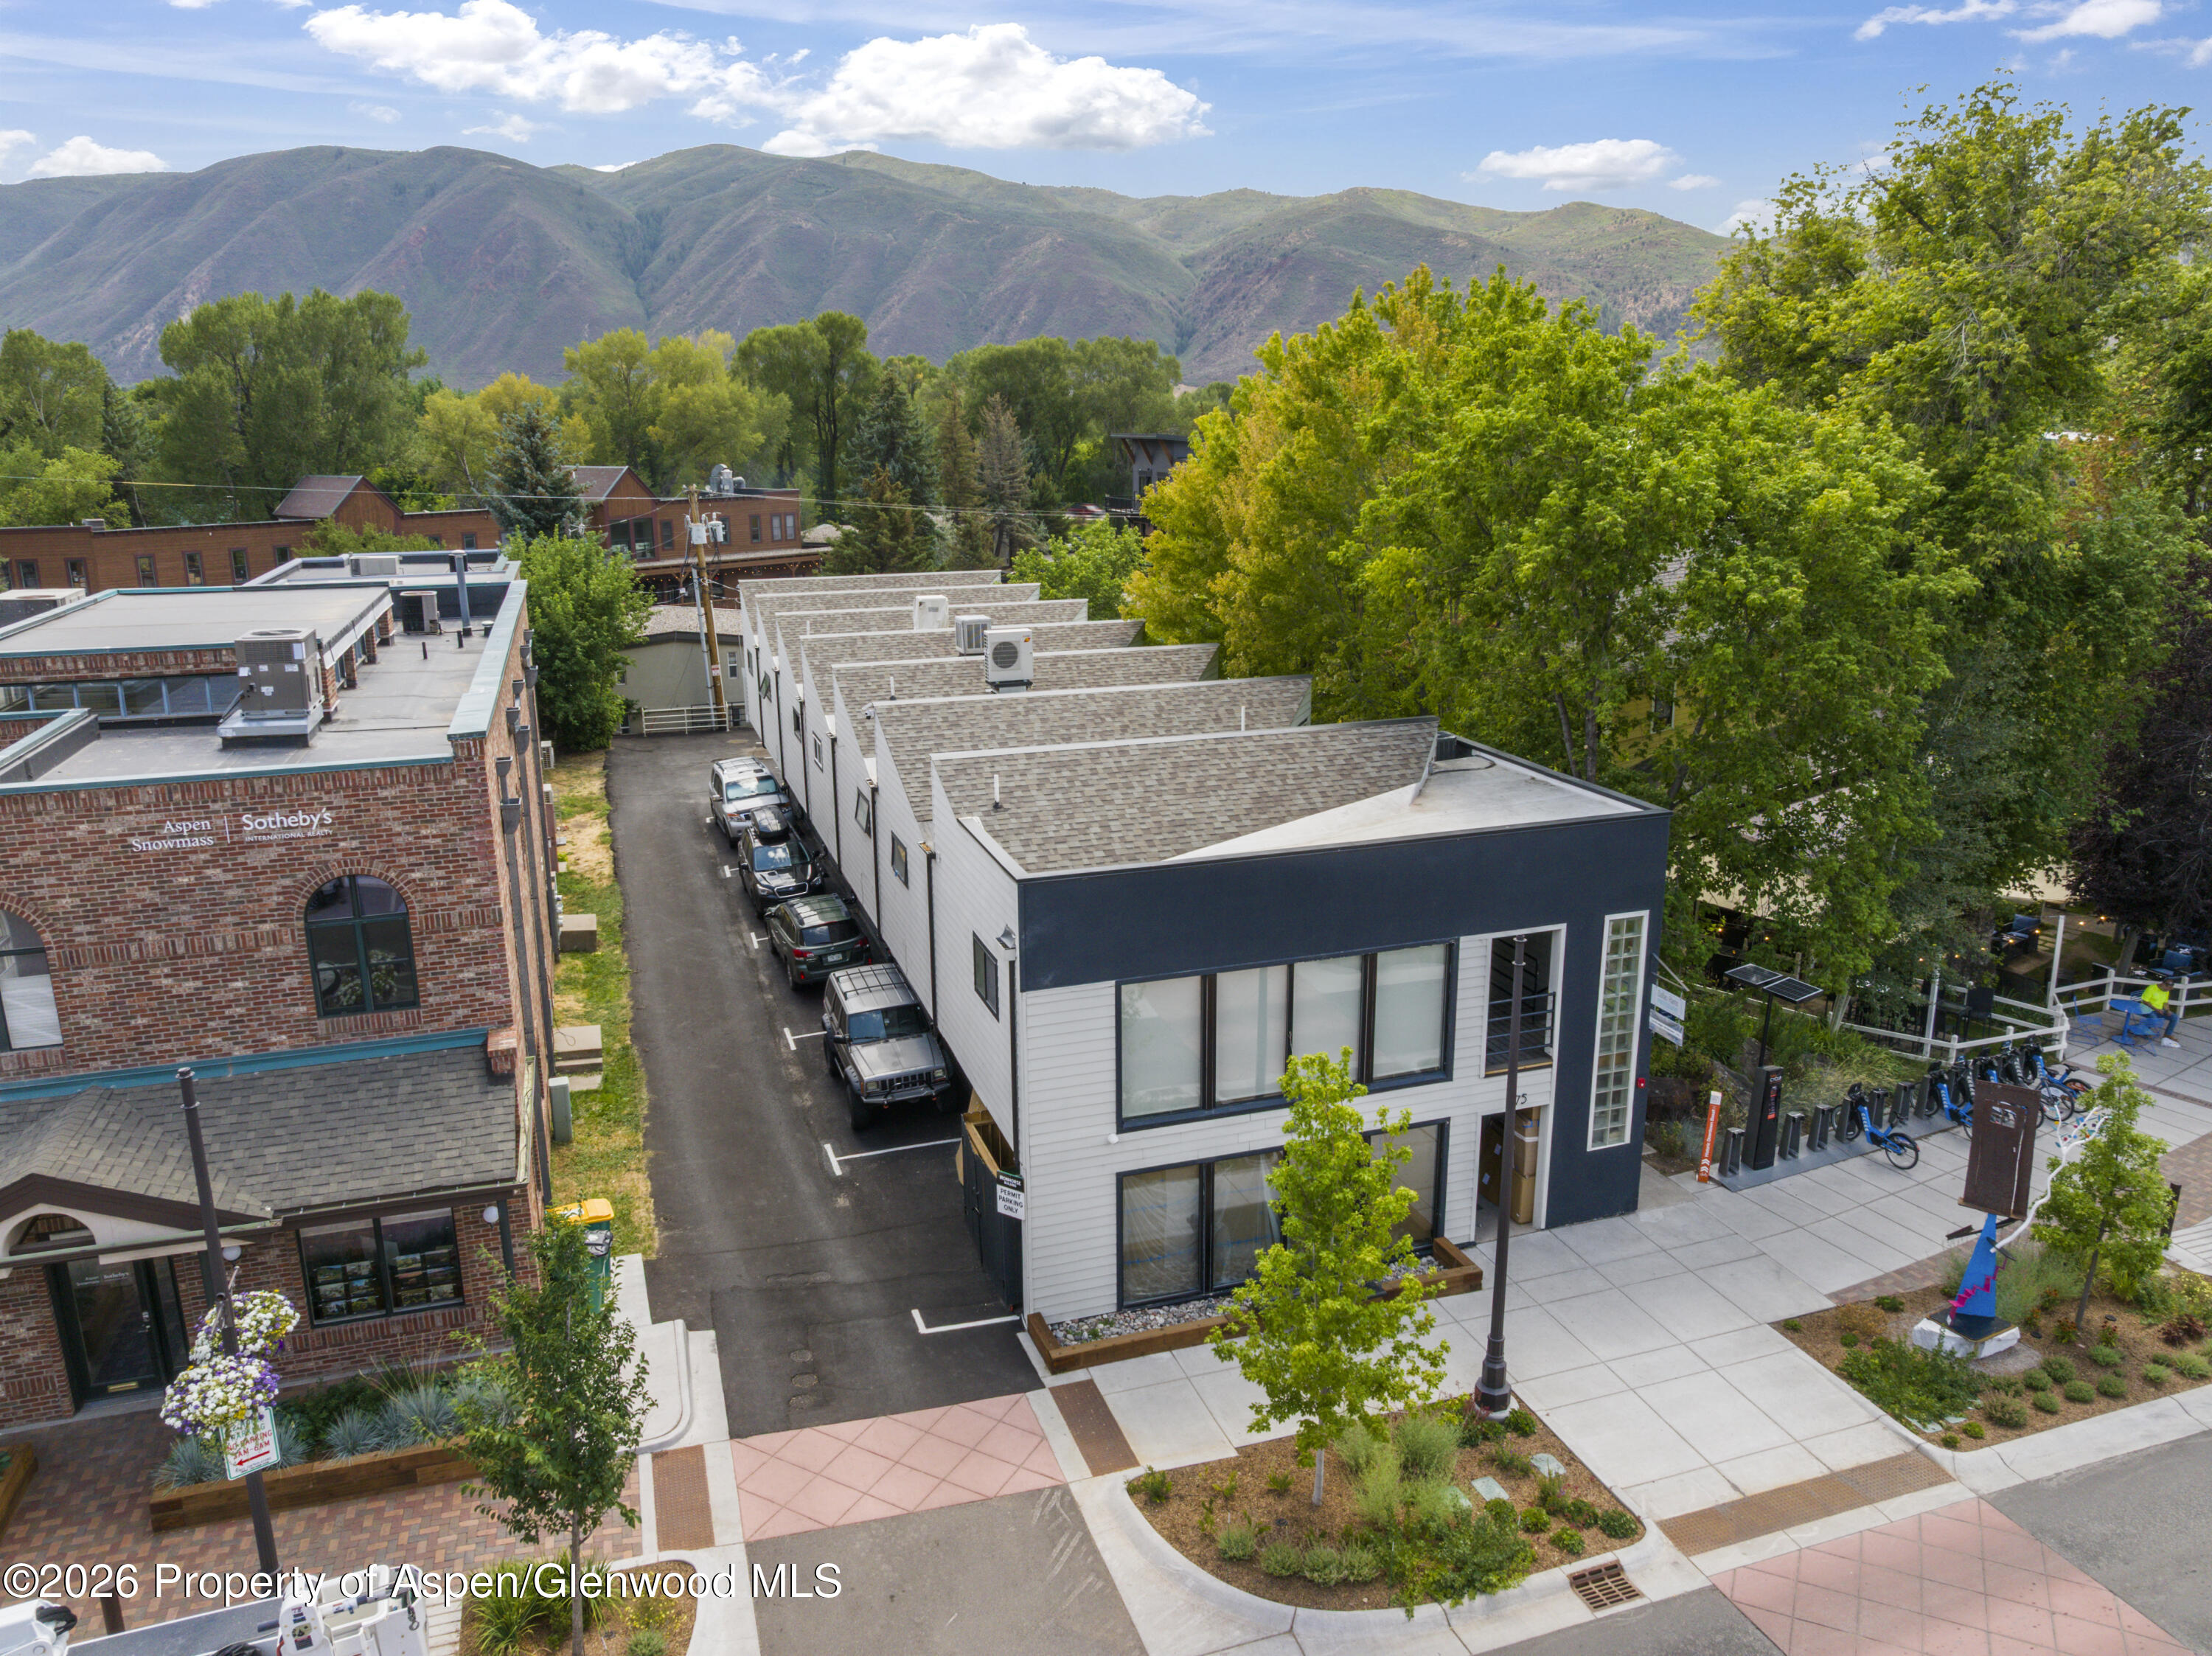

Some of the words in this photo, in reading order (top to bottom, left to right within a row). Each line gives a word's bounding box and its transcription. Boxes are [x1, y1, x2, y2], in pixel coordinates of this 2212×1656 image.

[242, 807, 332, 830] Sotheby's
[163, 820, 212, 835] Aspen
[245, 832, 305, 841] INTERNATIONAL
[132, 836, 214, 852] Snowmass
[1000, 1188, 1021, 1200] PERMIT
[998, 1195, 1023, 1208] PARKING
[1004, 1204, 1018, 1214] ONLY
